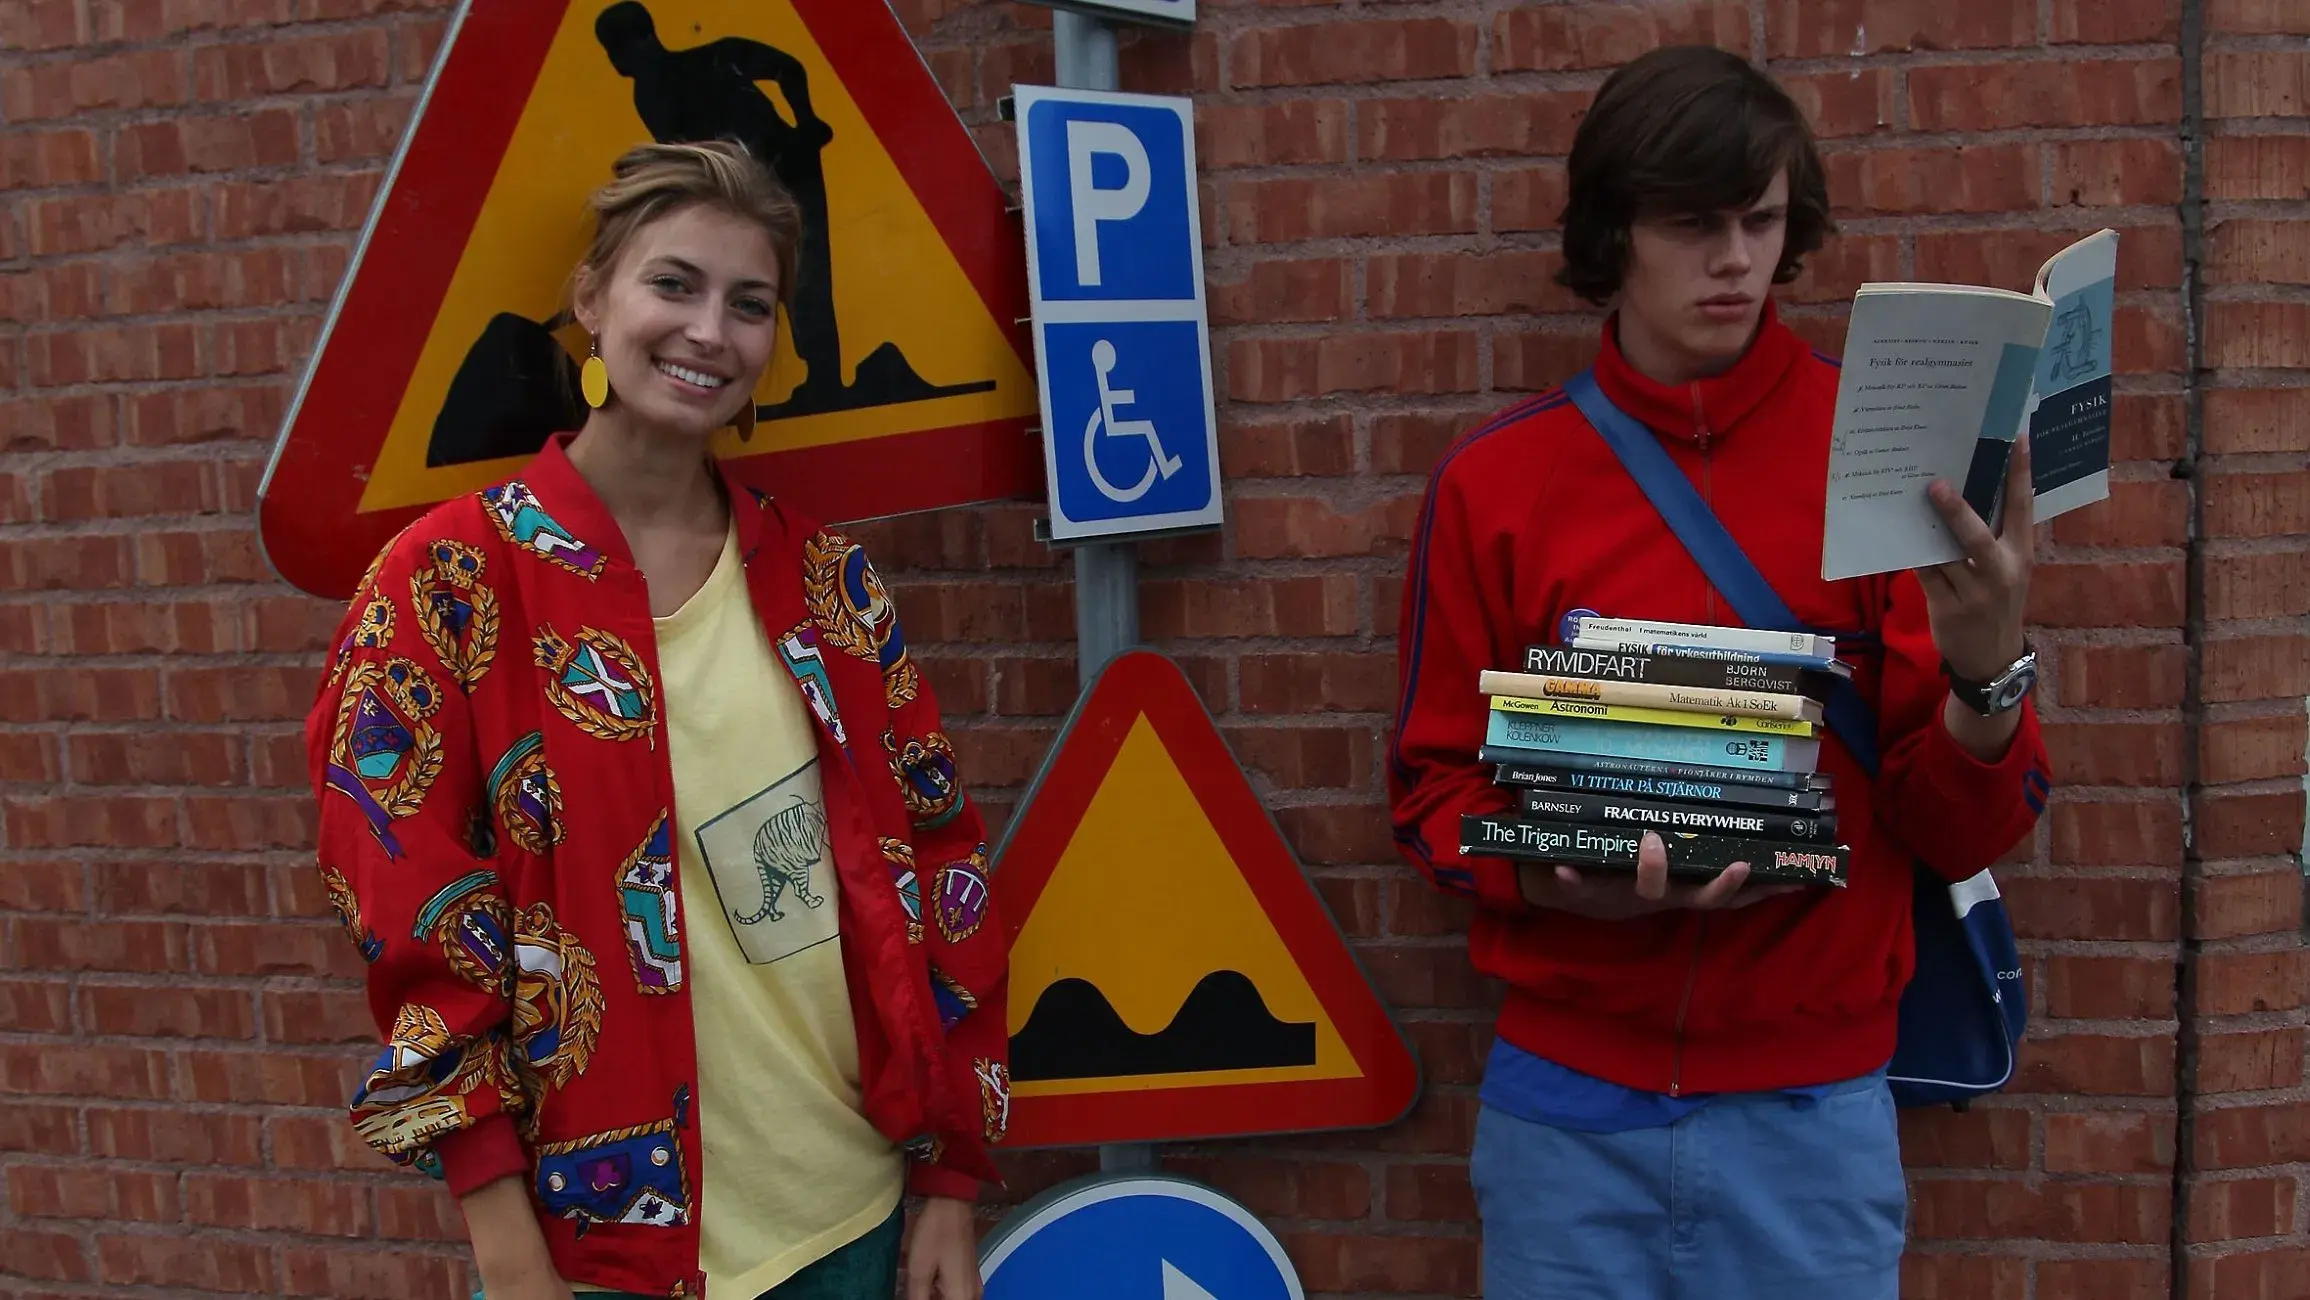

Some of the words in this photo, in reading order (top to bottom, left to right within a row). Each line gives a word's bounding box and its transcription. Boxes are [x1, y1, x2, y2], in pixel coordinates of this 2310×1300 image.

[1066, 120, 1151, 287] P
[2071, 395, 2107, 415] FYSIK
[1588, 623, 1632, 633] Freudenthal
[1618, 642, 1649, 655] FYSIK
[1656, 646, 1674, 657] för
[1527, 647, 1651, 679] RYMDFART
[1543, 680, 1602, 700] GAMMA
[1725, 676, 1792, 690] BERGQVIST
[1503, 699, 1539, 710] McGowen
[1550, 700, 1608, 716] Astronomi
[1669, 692, 1723, 707] Matematik
[1506, 730, 1561, 744] KOLENKOW
[1512, 770, 1534, 781] Brian
[1533, 772, 1557, 783] Jones
[1594, 761, 1668, 774] ASTRONAUTERNA
[1736, 773, 1775, 784] RYMDEN
[1571, 773, 1584, 787] VI
[1587, 775, 1635, 792] TITTAR
[1637, 777, 1653, 793] PÅ
[1656, 780, 1722, 799] STJÄRNOR
[1531, 800, 1582, 814] BARNSLEY
[1604, 805, 1670, 824] FRACTALS
[1671, 812, 1765, 832] EVERYWHERE
[1482, 820, 1516, 843] The
[1517, 824, 1570, 852] Trigan
[1576, 829, 1638, 857] Empire
[1775, 851, 1837, 875] HAMLYN
